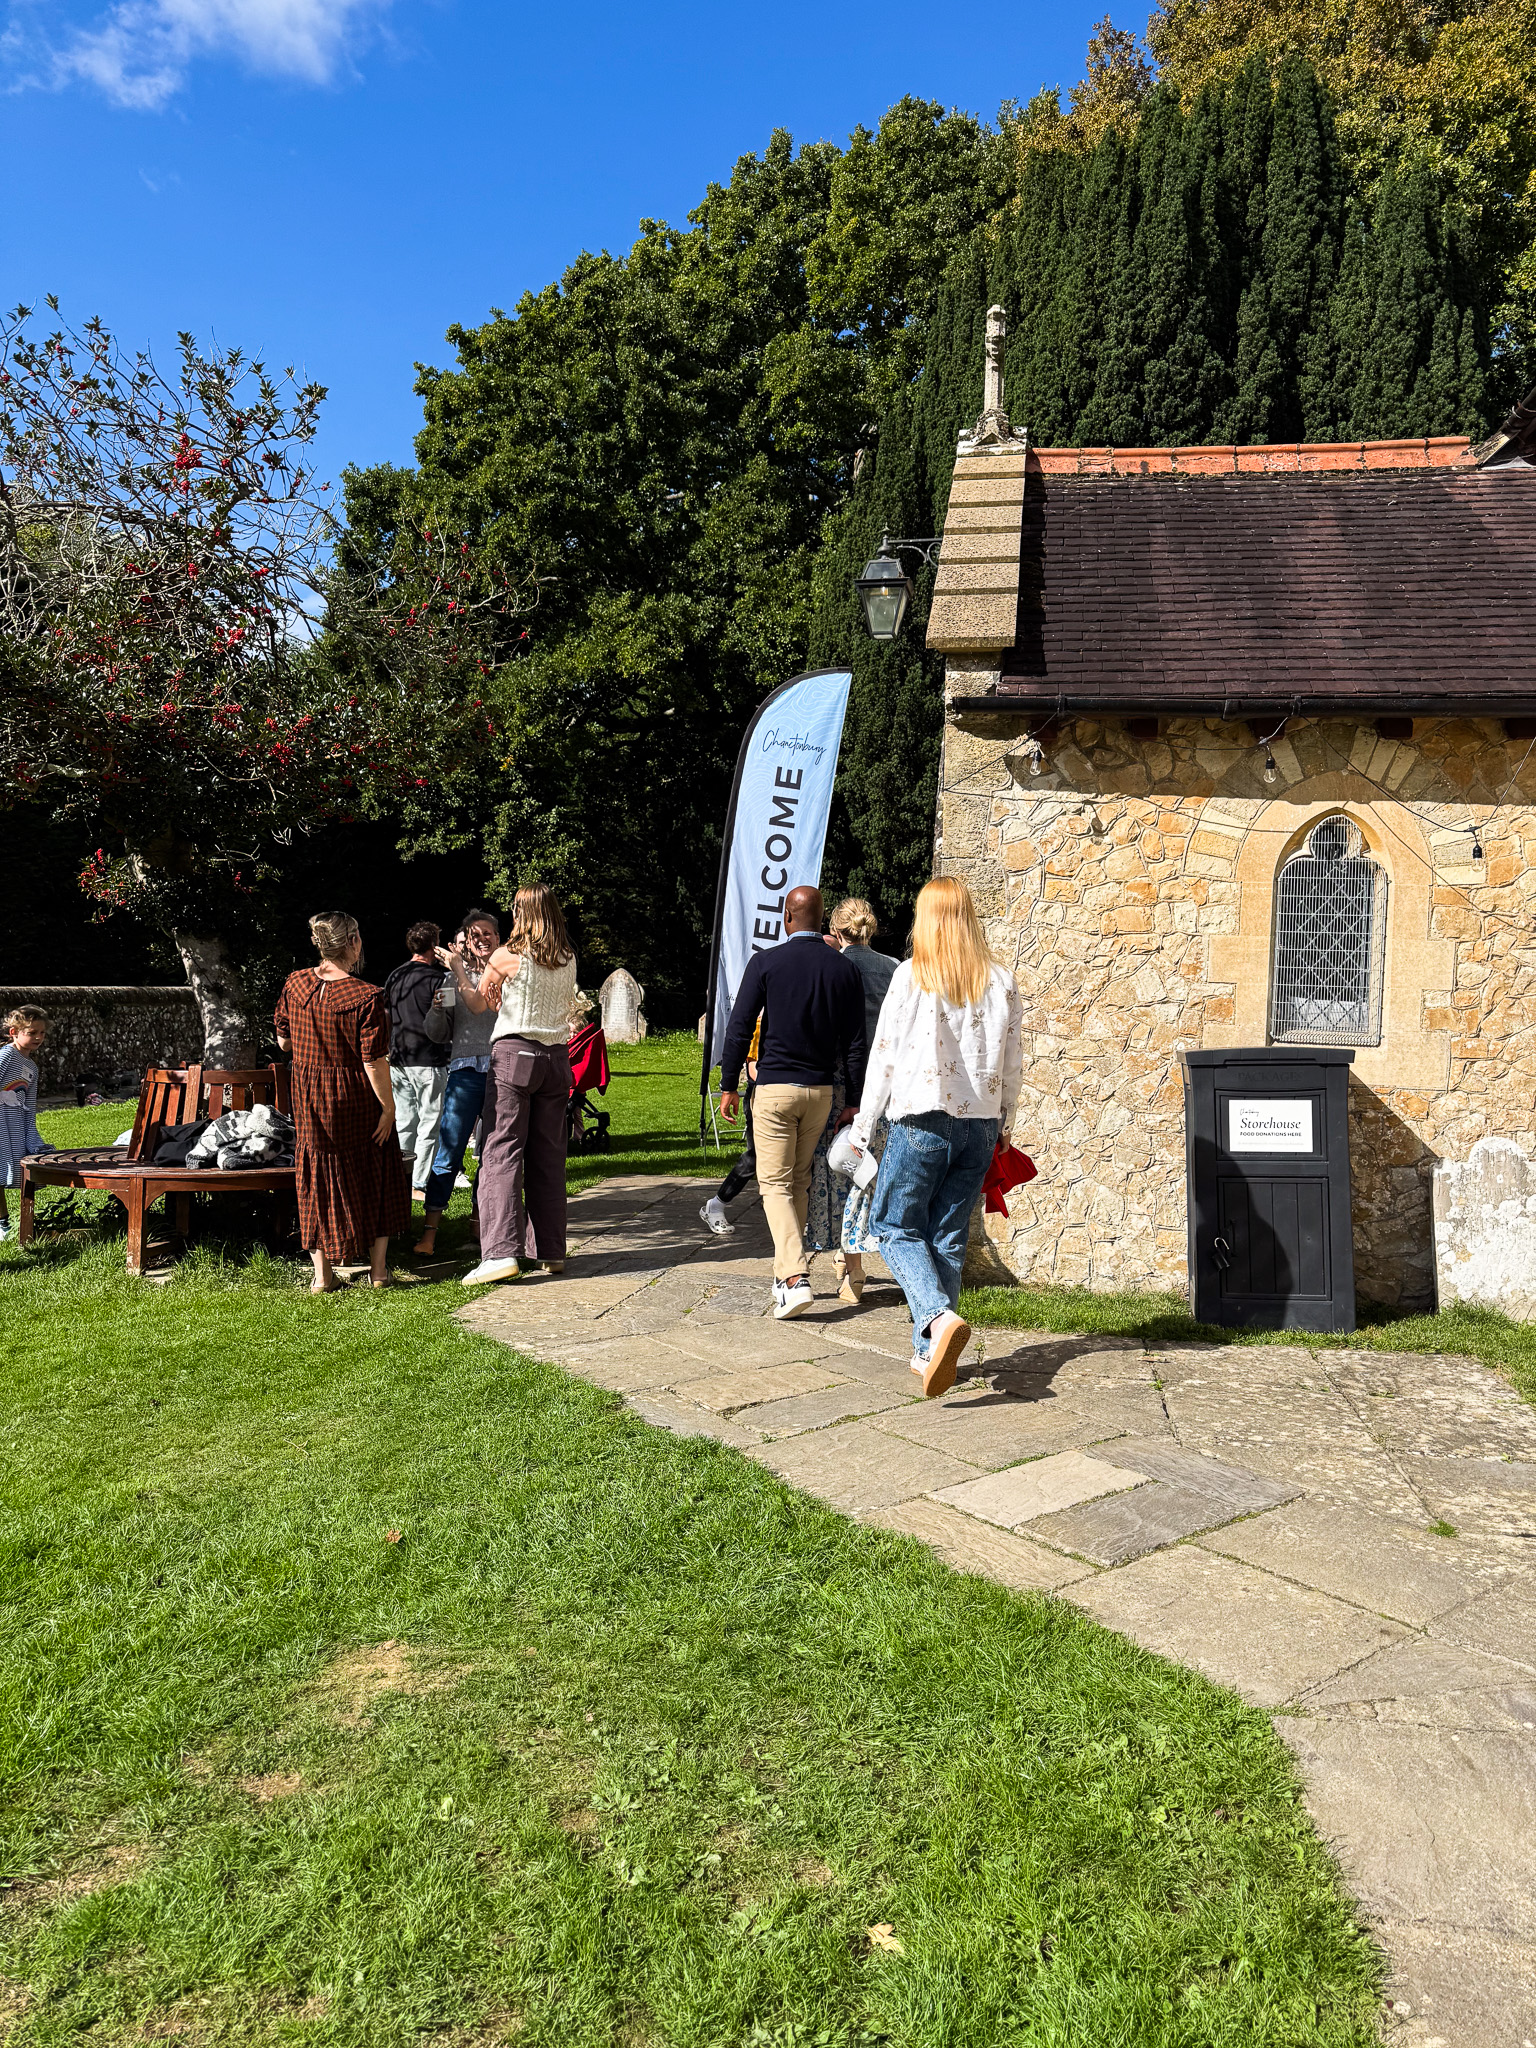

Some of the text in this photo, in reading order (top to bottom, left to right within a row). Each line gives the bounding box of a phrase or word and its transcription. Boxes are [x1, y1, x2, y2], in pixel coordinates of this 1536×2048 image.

[762, 727, 827, 765] Chanctonbury
[752, 766, 803, 952] ELCOME
[1240, 1117, 1302, 1129] Storehouse
